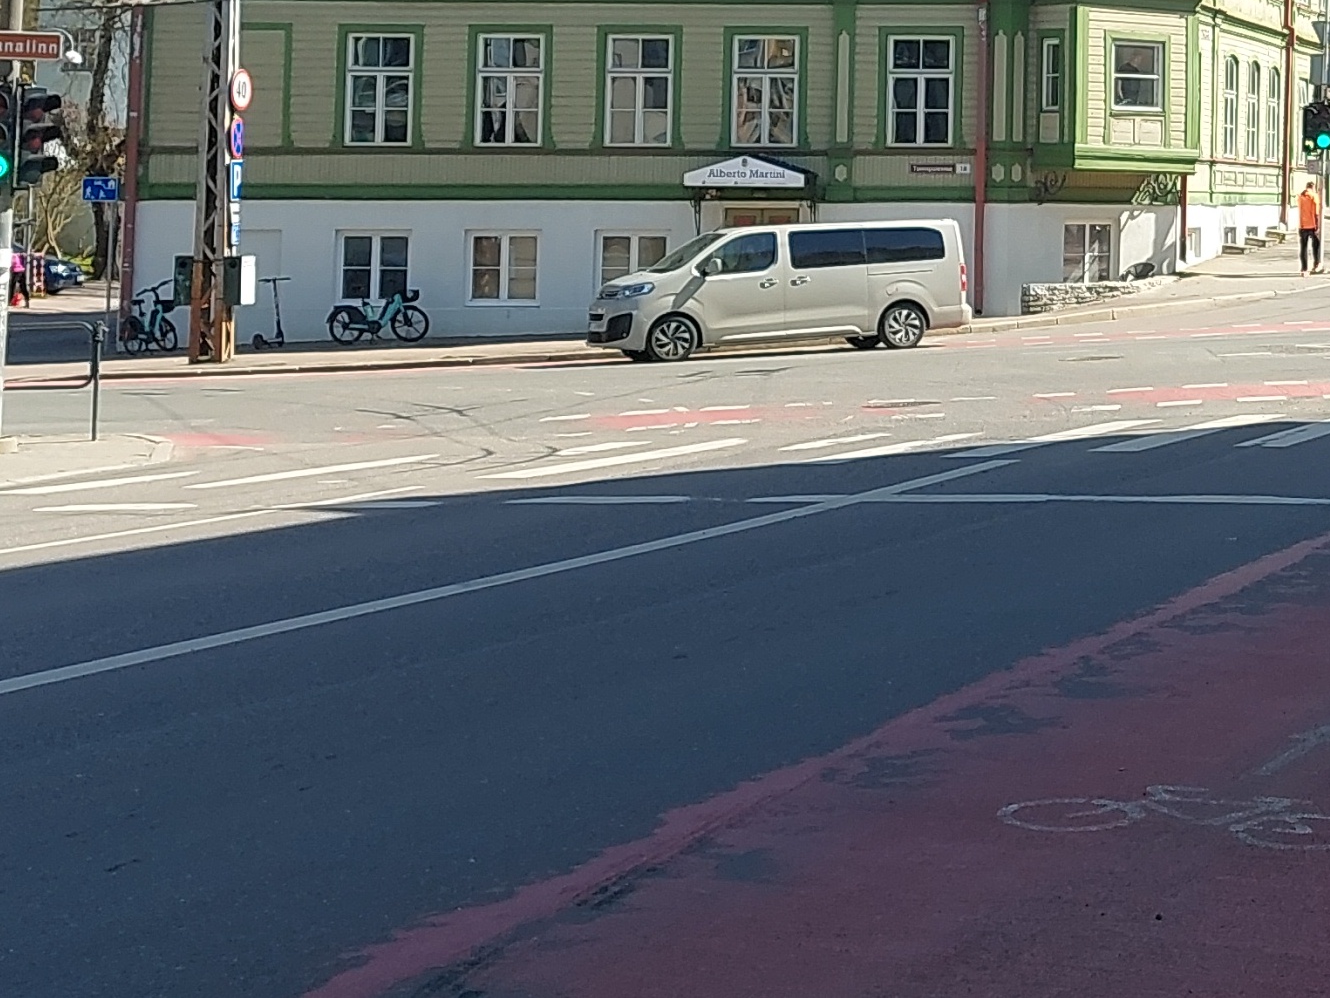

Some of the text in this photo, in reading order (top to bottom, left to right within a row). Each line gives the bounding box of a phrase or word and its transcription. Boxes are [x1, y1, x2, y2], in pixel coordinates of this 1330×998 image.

[236, 81, 246, 98] 40
[707, 169, 785, 179] Alberto Martini
